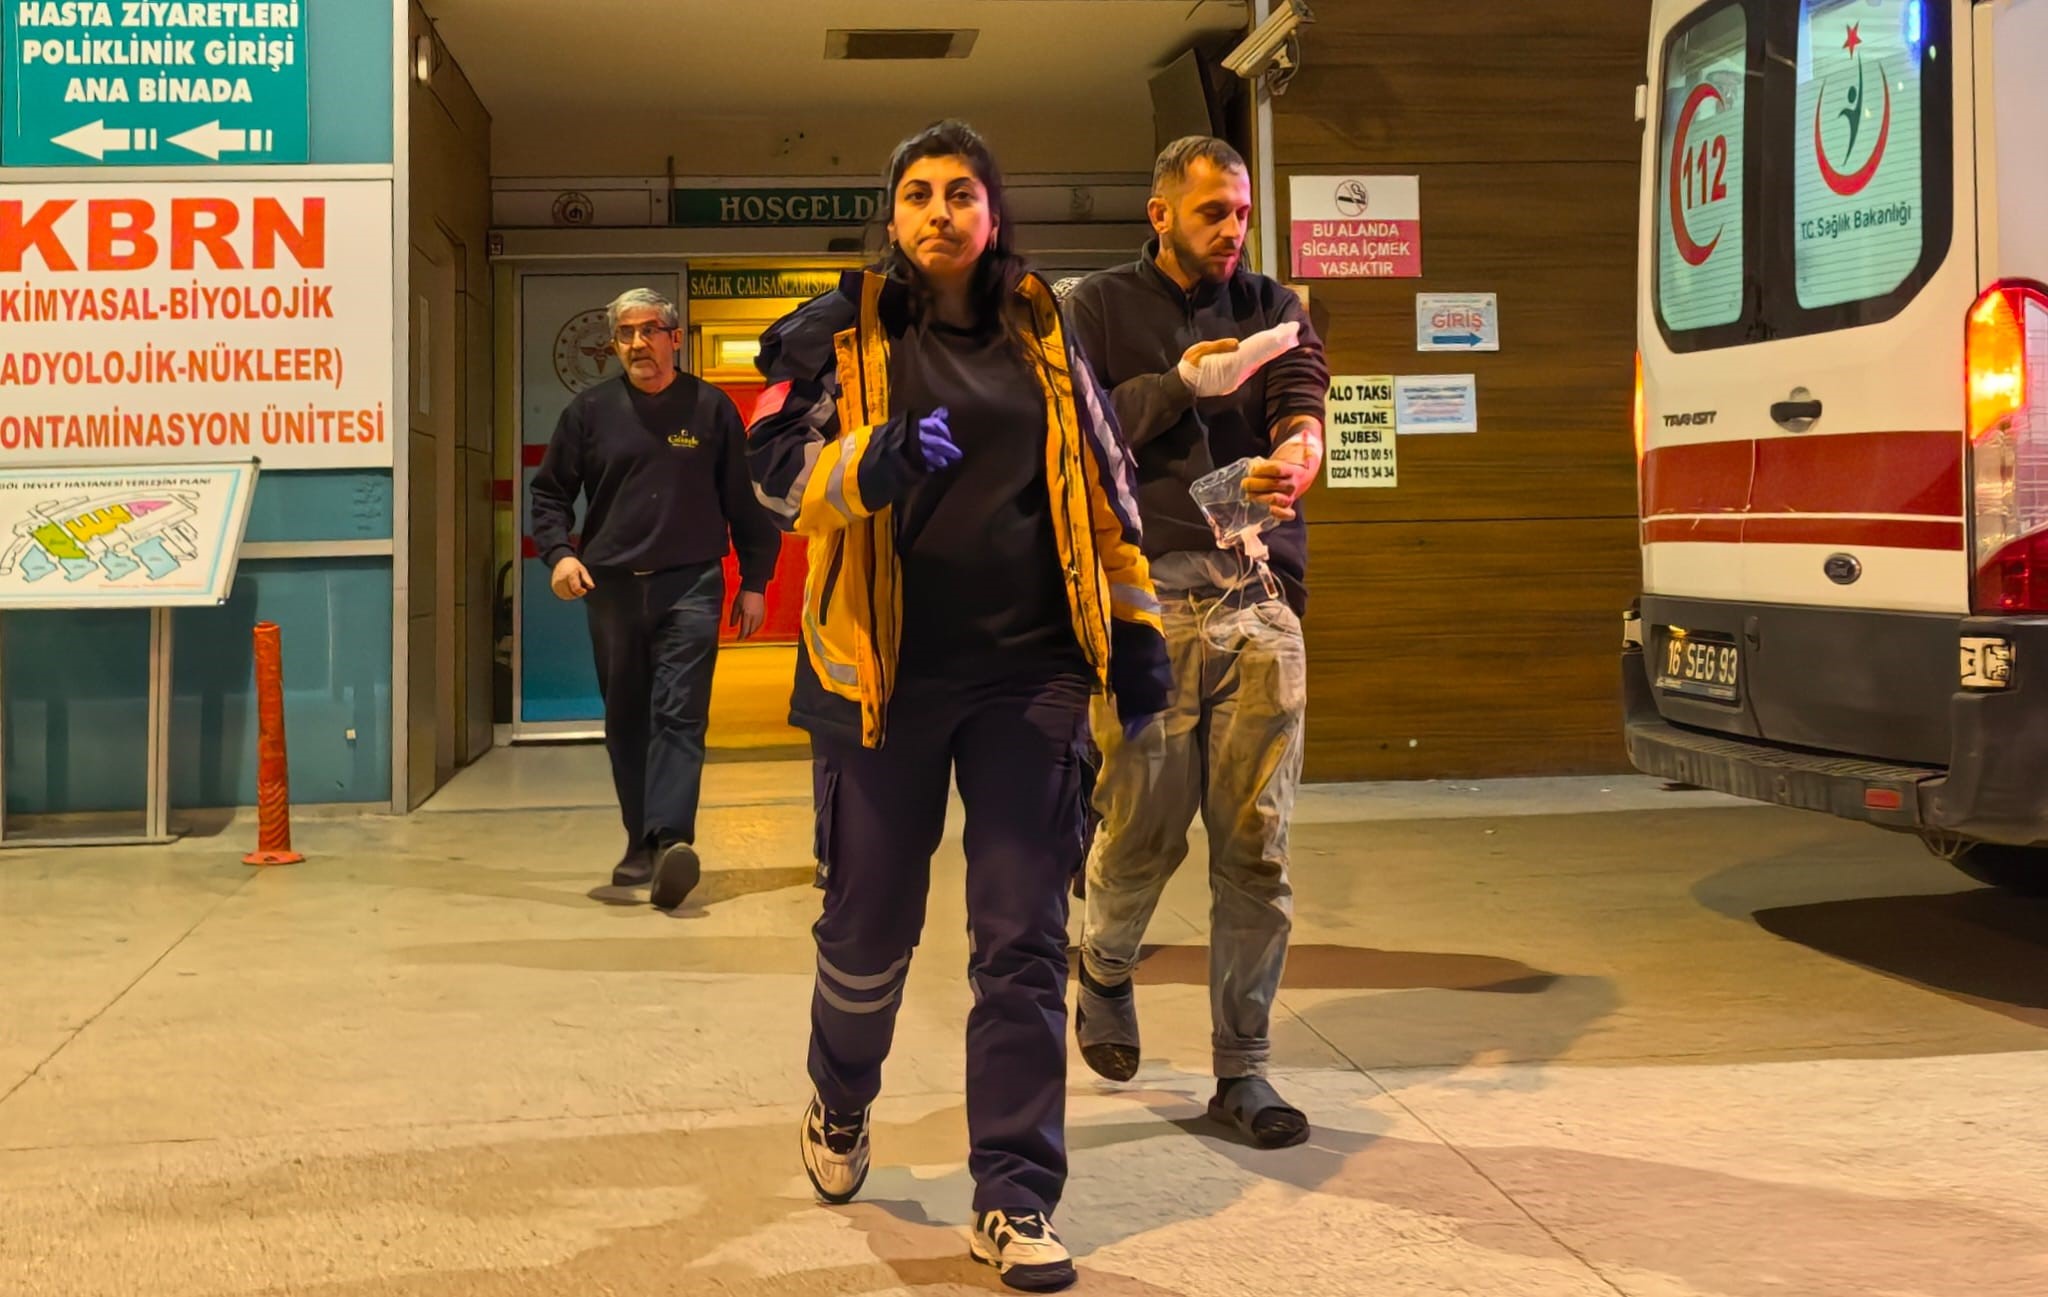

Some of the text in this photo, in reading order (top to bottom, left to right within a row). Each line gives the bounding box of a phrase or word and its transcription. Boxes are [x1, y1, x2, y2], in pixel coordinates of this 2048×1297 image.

[19, 0, 299, 28] HASTA ZİYARETLERİ
[23, 32, 295, 72] POLİKLİNİK GİRİŞİ
[64, 70, 253, 103] ANA BİNADA
[1683, 134, 1727, 210] 112
[1312, 223, 1400, 238] BU ALANDA
[1817, 213, 1851, 239] Sağlık
[1854, 201, 1912, 229] Bakanlığı
[0, 197, 326, 273] KBRN
[1302, 240, 1411, 260] SİGARA İÇMEK
[1321, 262, 1394, 276] YASAKTIR
[690, 274, 733, 296] SAĞLIK
[1, 277, 334, 322] KİMYASAL-BİYOLOJİK
[1431, 309, 1484, 332] GİRİŞ
[0, 342, 344, 389] ADYOLOJİK-NÜKLEER)
[1329, 386, 1353, 401] ALO
[0, 402, 385, 449] ONTAMİNASYON ÜNİTESİ
[1334, 411, 1388, 425] HASTANE
[1331, 449, 1351, 461] 0224
[1354, 449, 1369, 461] 713
[1383, 448, 1393, 460] 51
[1331, 467, 1352, 479] 0224
[1372, 467, 1382, 478] 34
[1384, 466, 1395, 477] 34
[1667, 640, 1738, 685] 16 SEG 93
